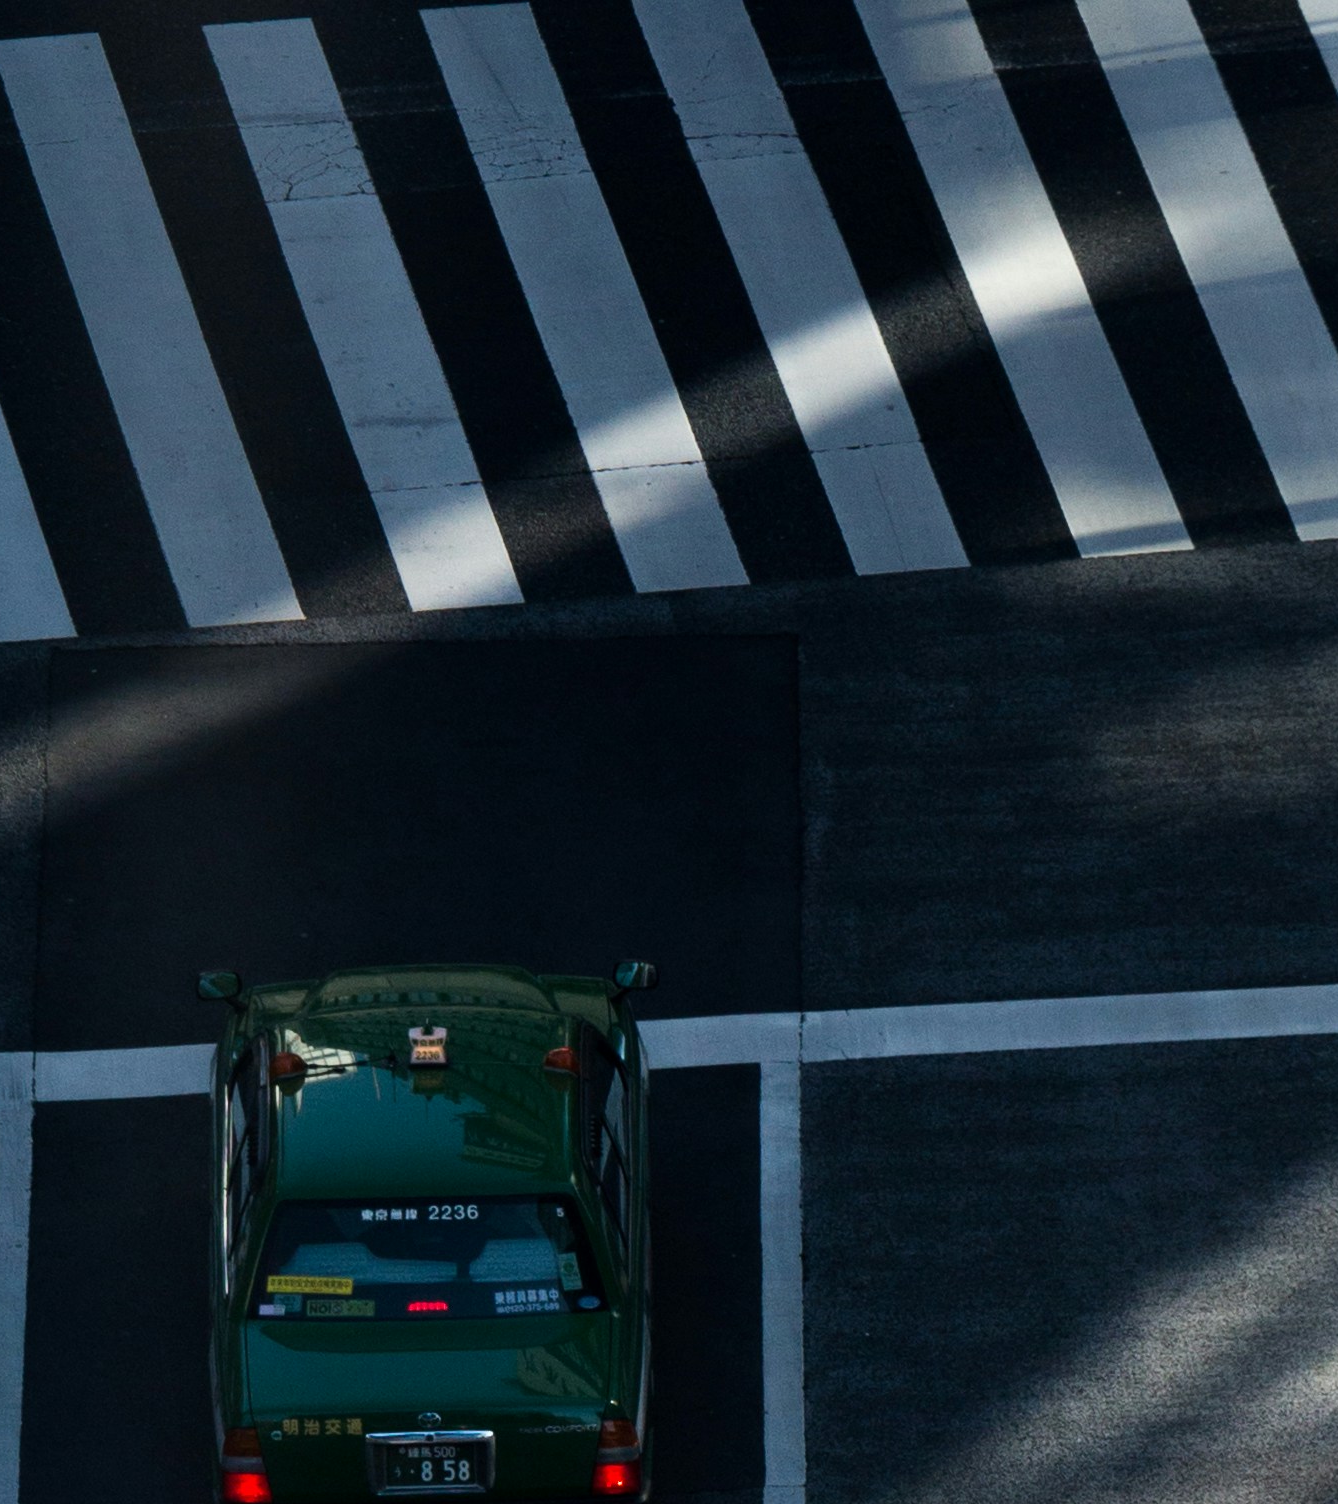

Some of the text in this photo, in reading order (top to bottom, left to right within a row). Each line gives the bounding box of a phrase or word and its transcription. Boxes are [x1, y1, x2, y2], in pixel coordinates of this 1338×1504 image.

[428, 1204, 479, 1220] 2236
[556, 1207, 565, 1218] 5
[282, 1418, 363, 1435] 明治交通
[434, 1446, 457, 1458] 500
